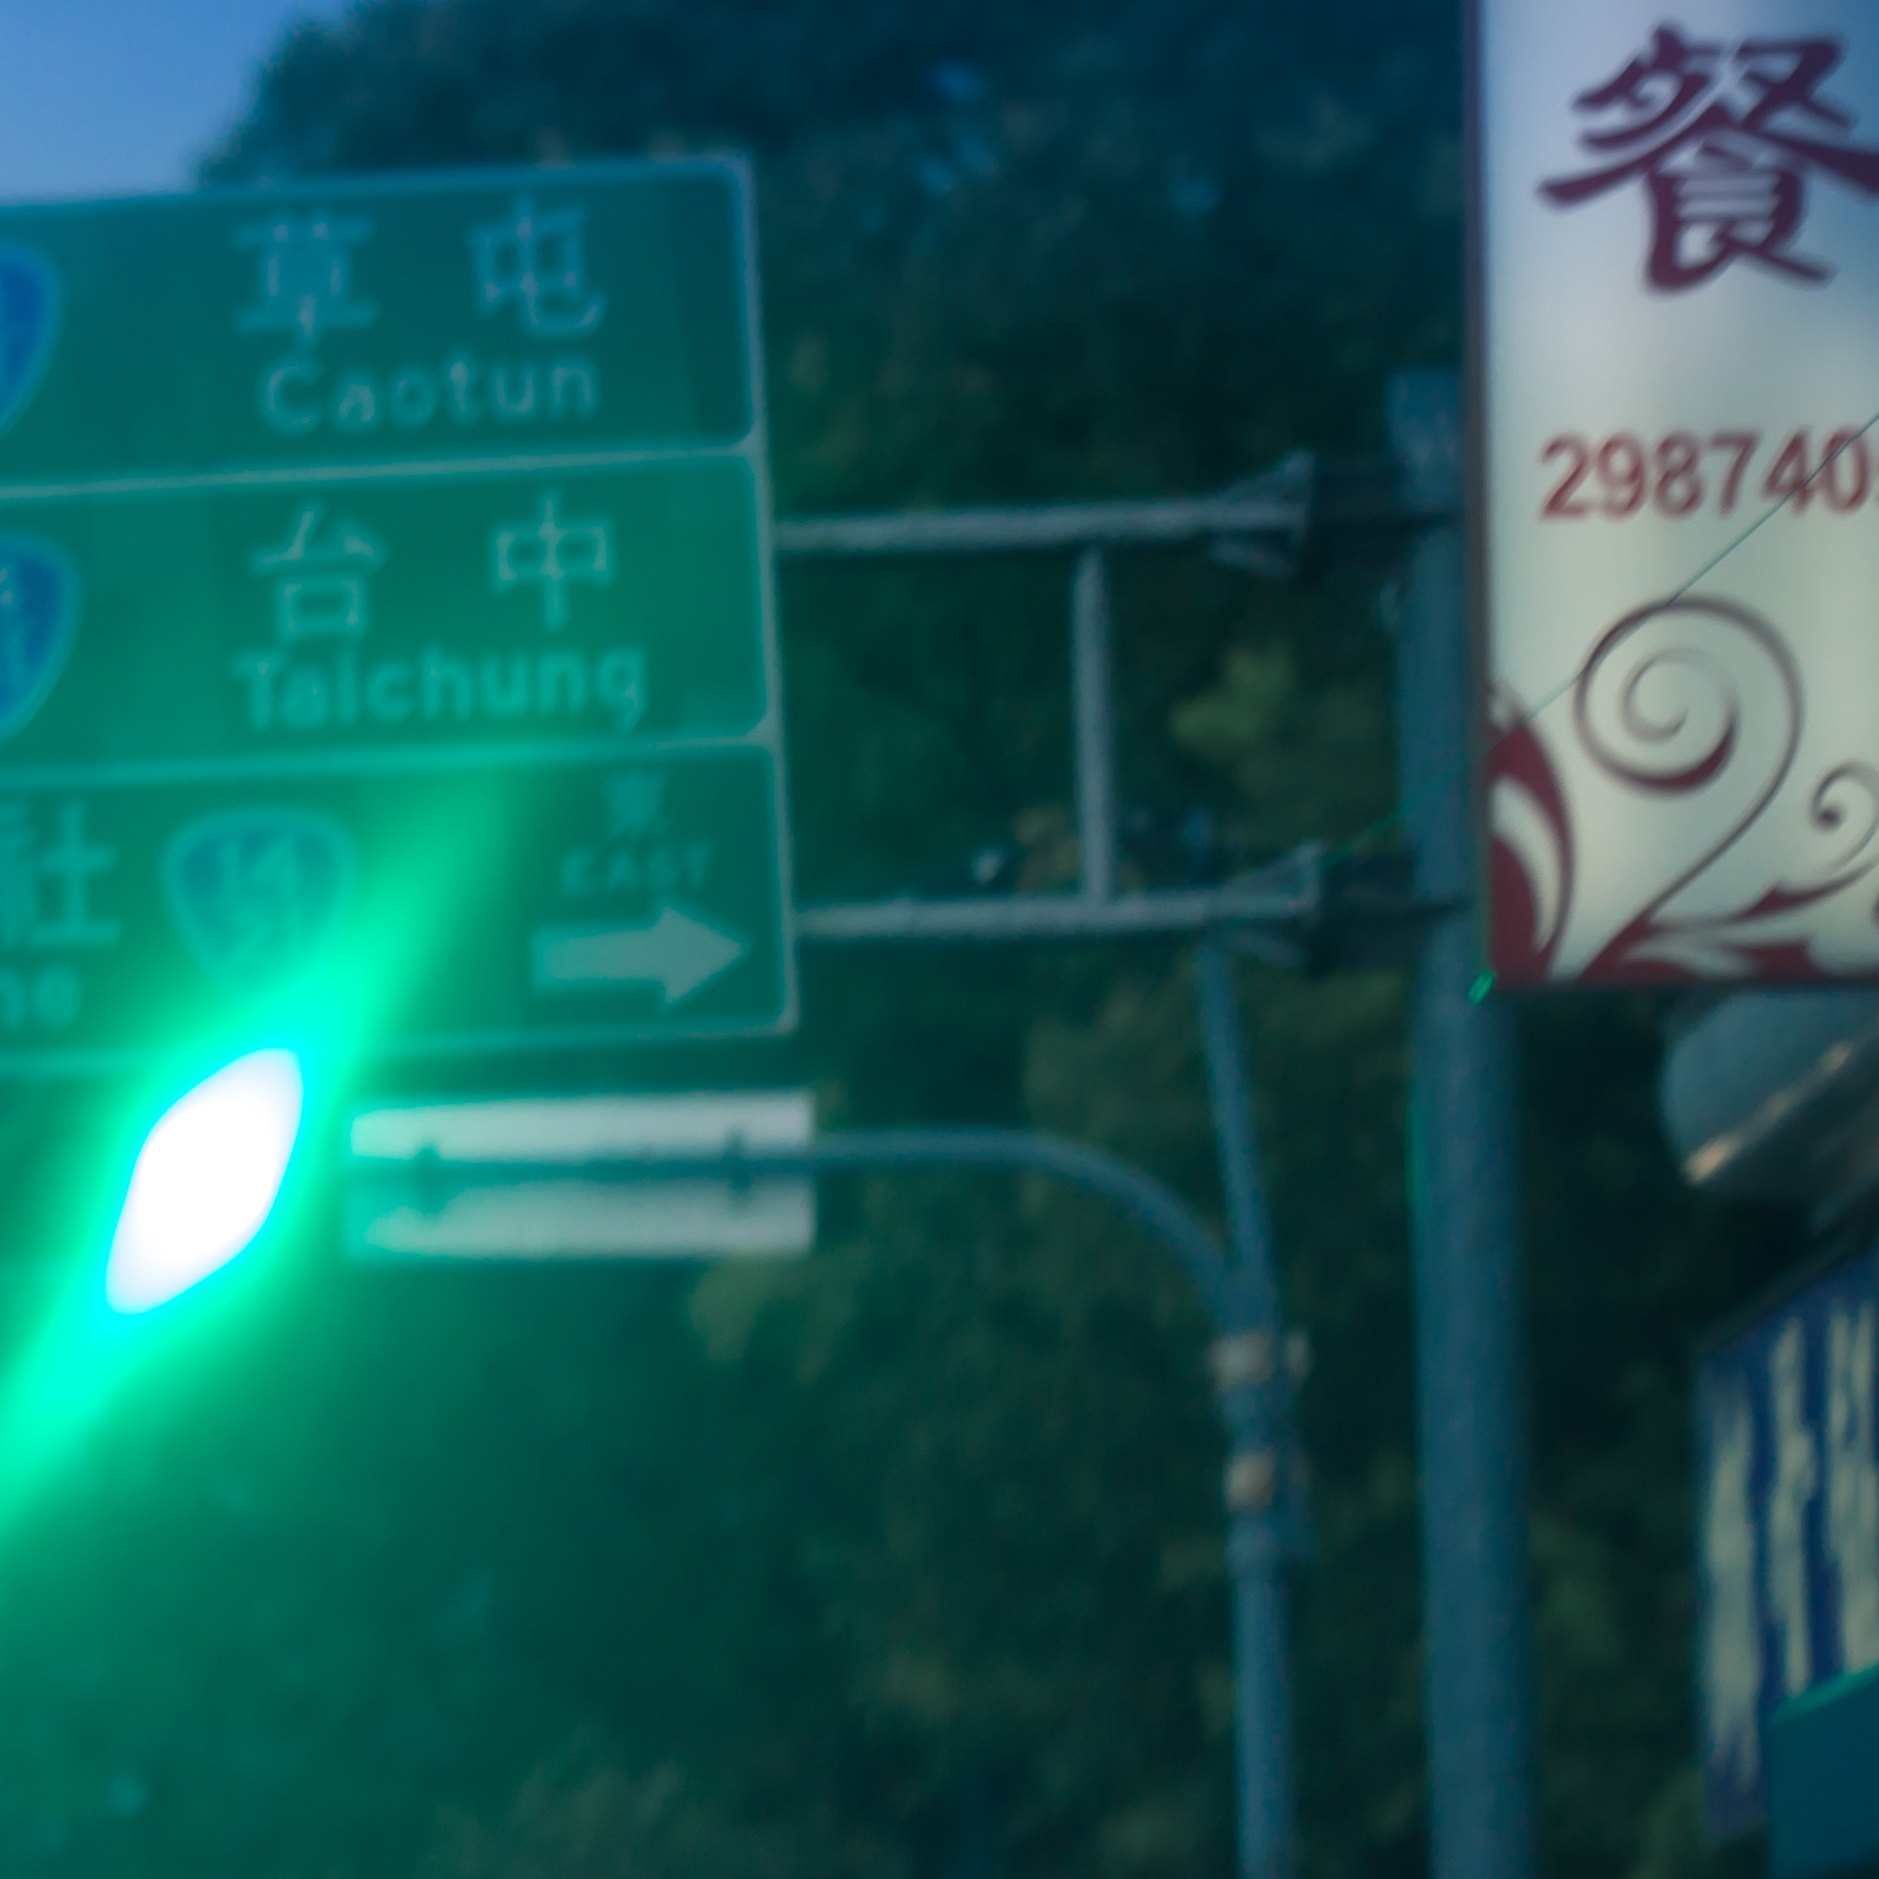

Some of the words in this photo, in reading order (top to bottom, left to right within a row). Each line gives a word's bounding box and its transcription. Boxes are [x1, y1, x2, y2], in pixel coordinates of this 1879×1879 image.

[1539, 22, 1879, 296] 餐
[235, 200, 605, 345] 草屯
[260, 350, 599, 436] Caotun
[1540, 424, 1879, 520] 298740
[251, 490, 615, 643] 台中
[235, 646, 646, 732] Taichung
